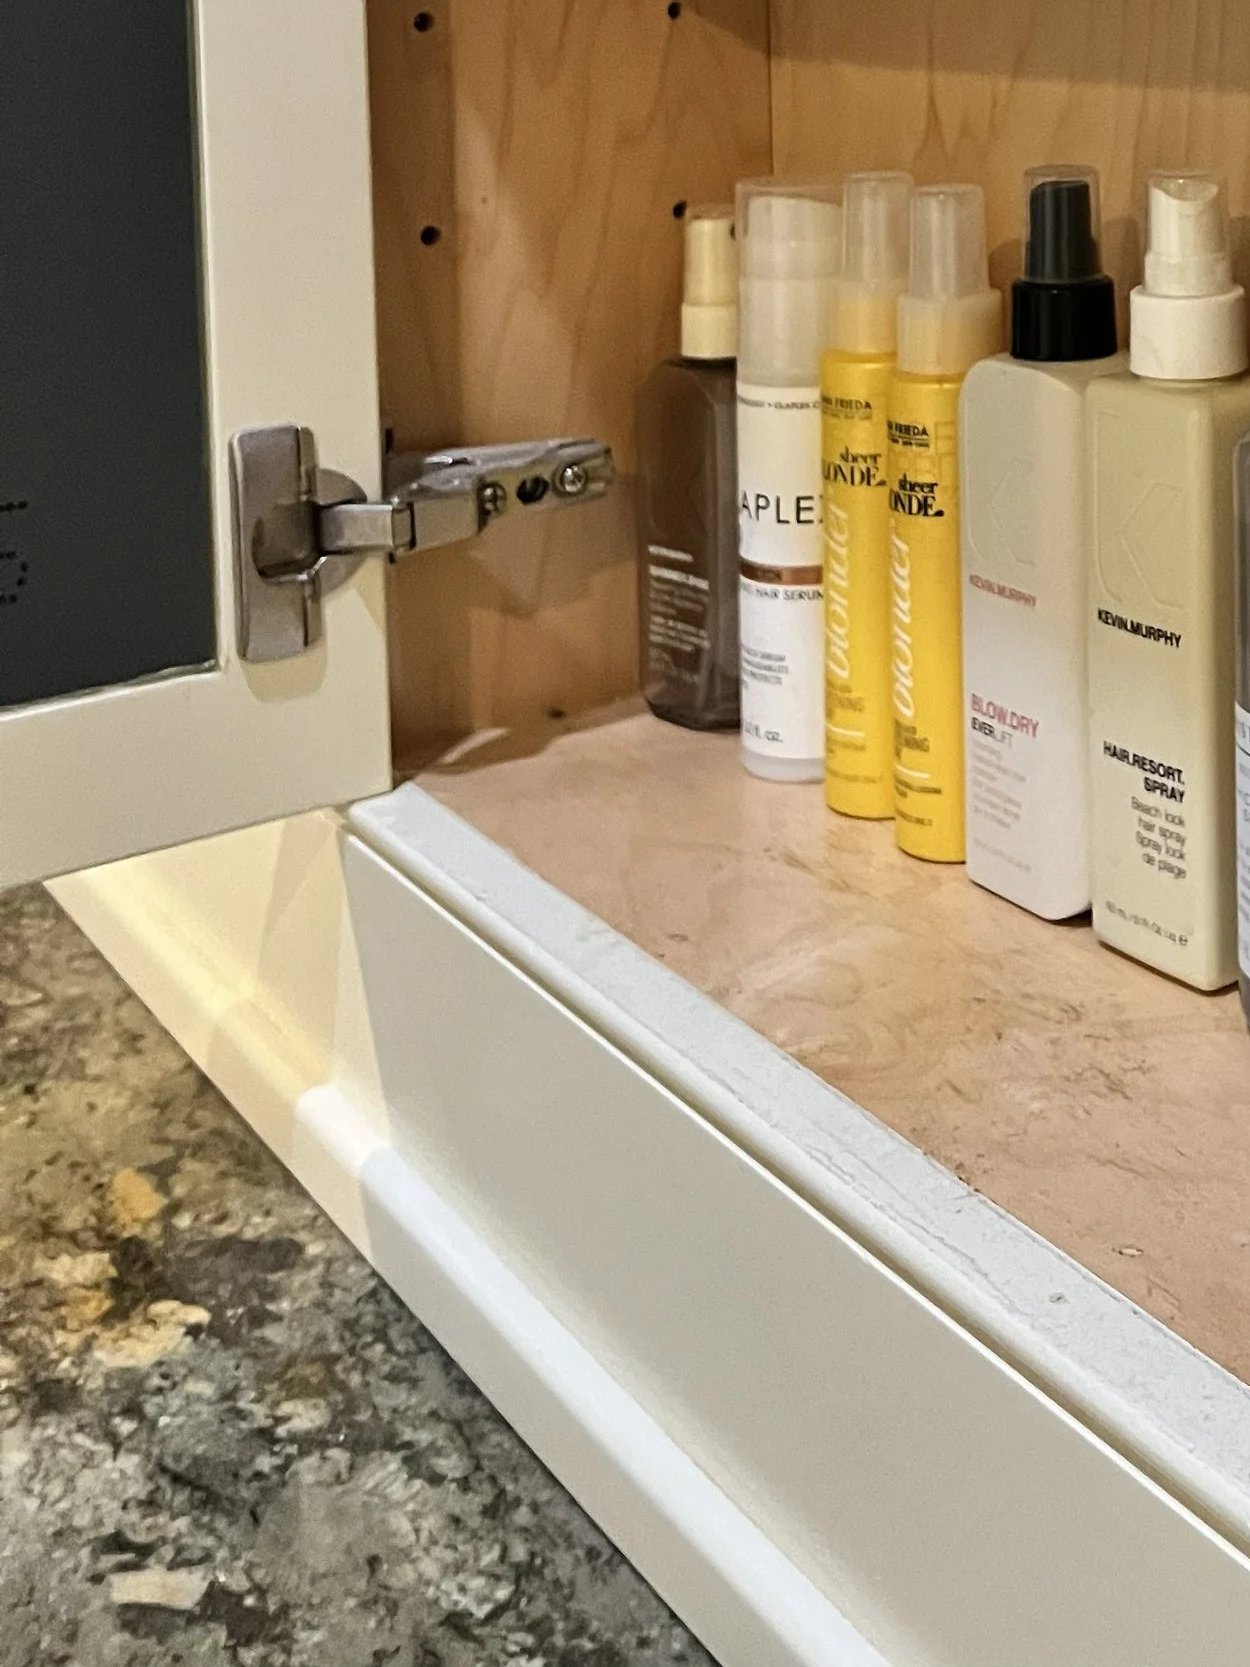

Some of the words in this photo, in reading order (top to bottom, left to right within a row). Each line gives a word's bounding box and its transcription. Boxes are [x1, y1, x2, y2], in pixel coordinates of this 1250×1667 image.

[840, 446, 882, 466] sheer
[899, 472, 938, 495] sheer
[741, 489, 823, 525] APLE
[1143, 776, 1185, 804] SPRAY
